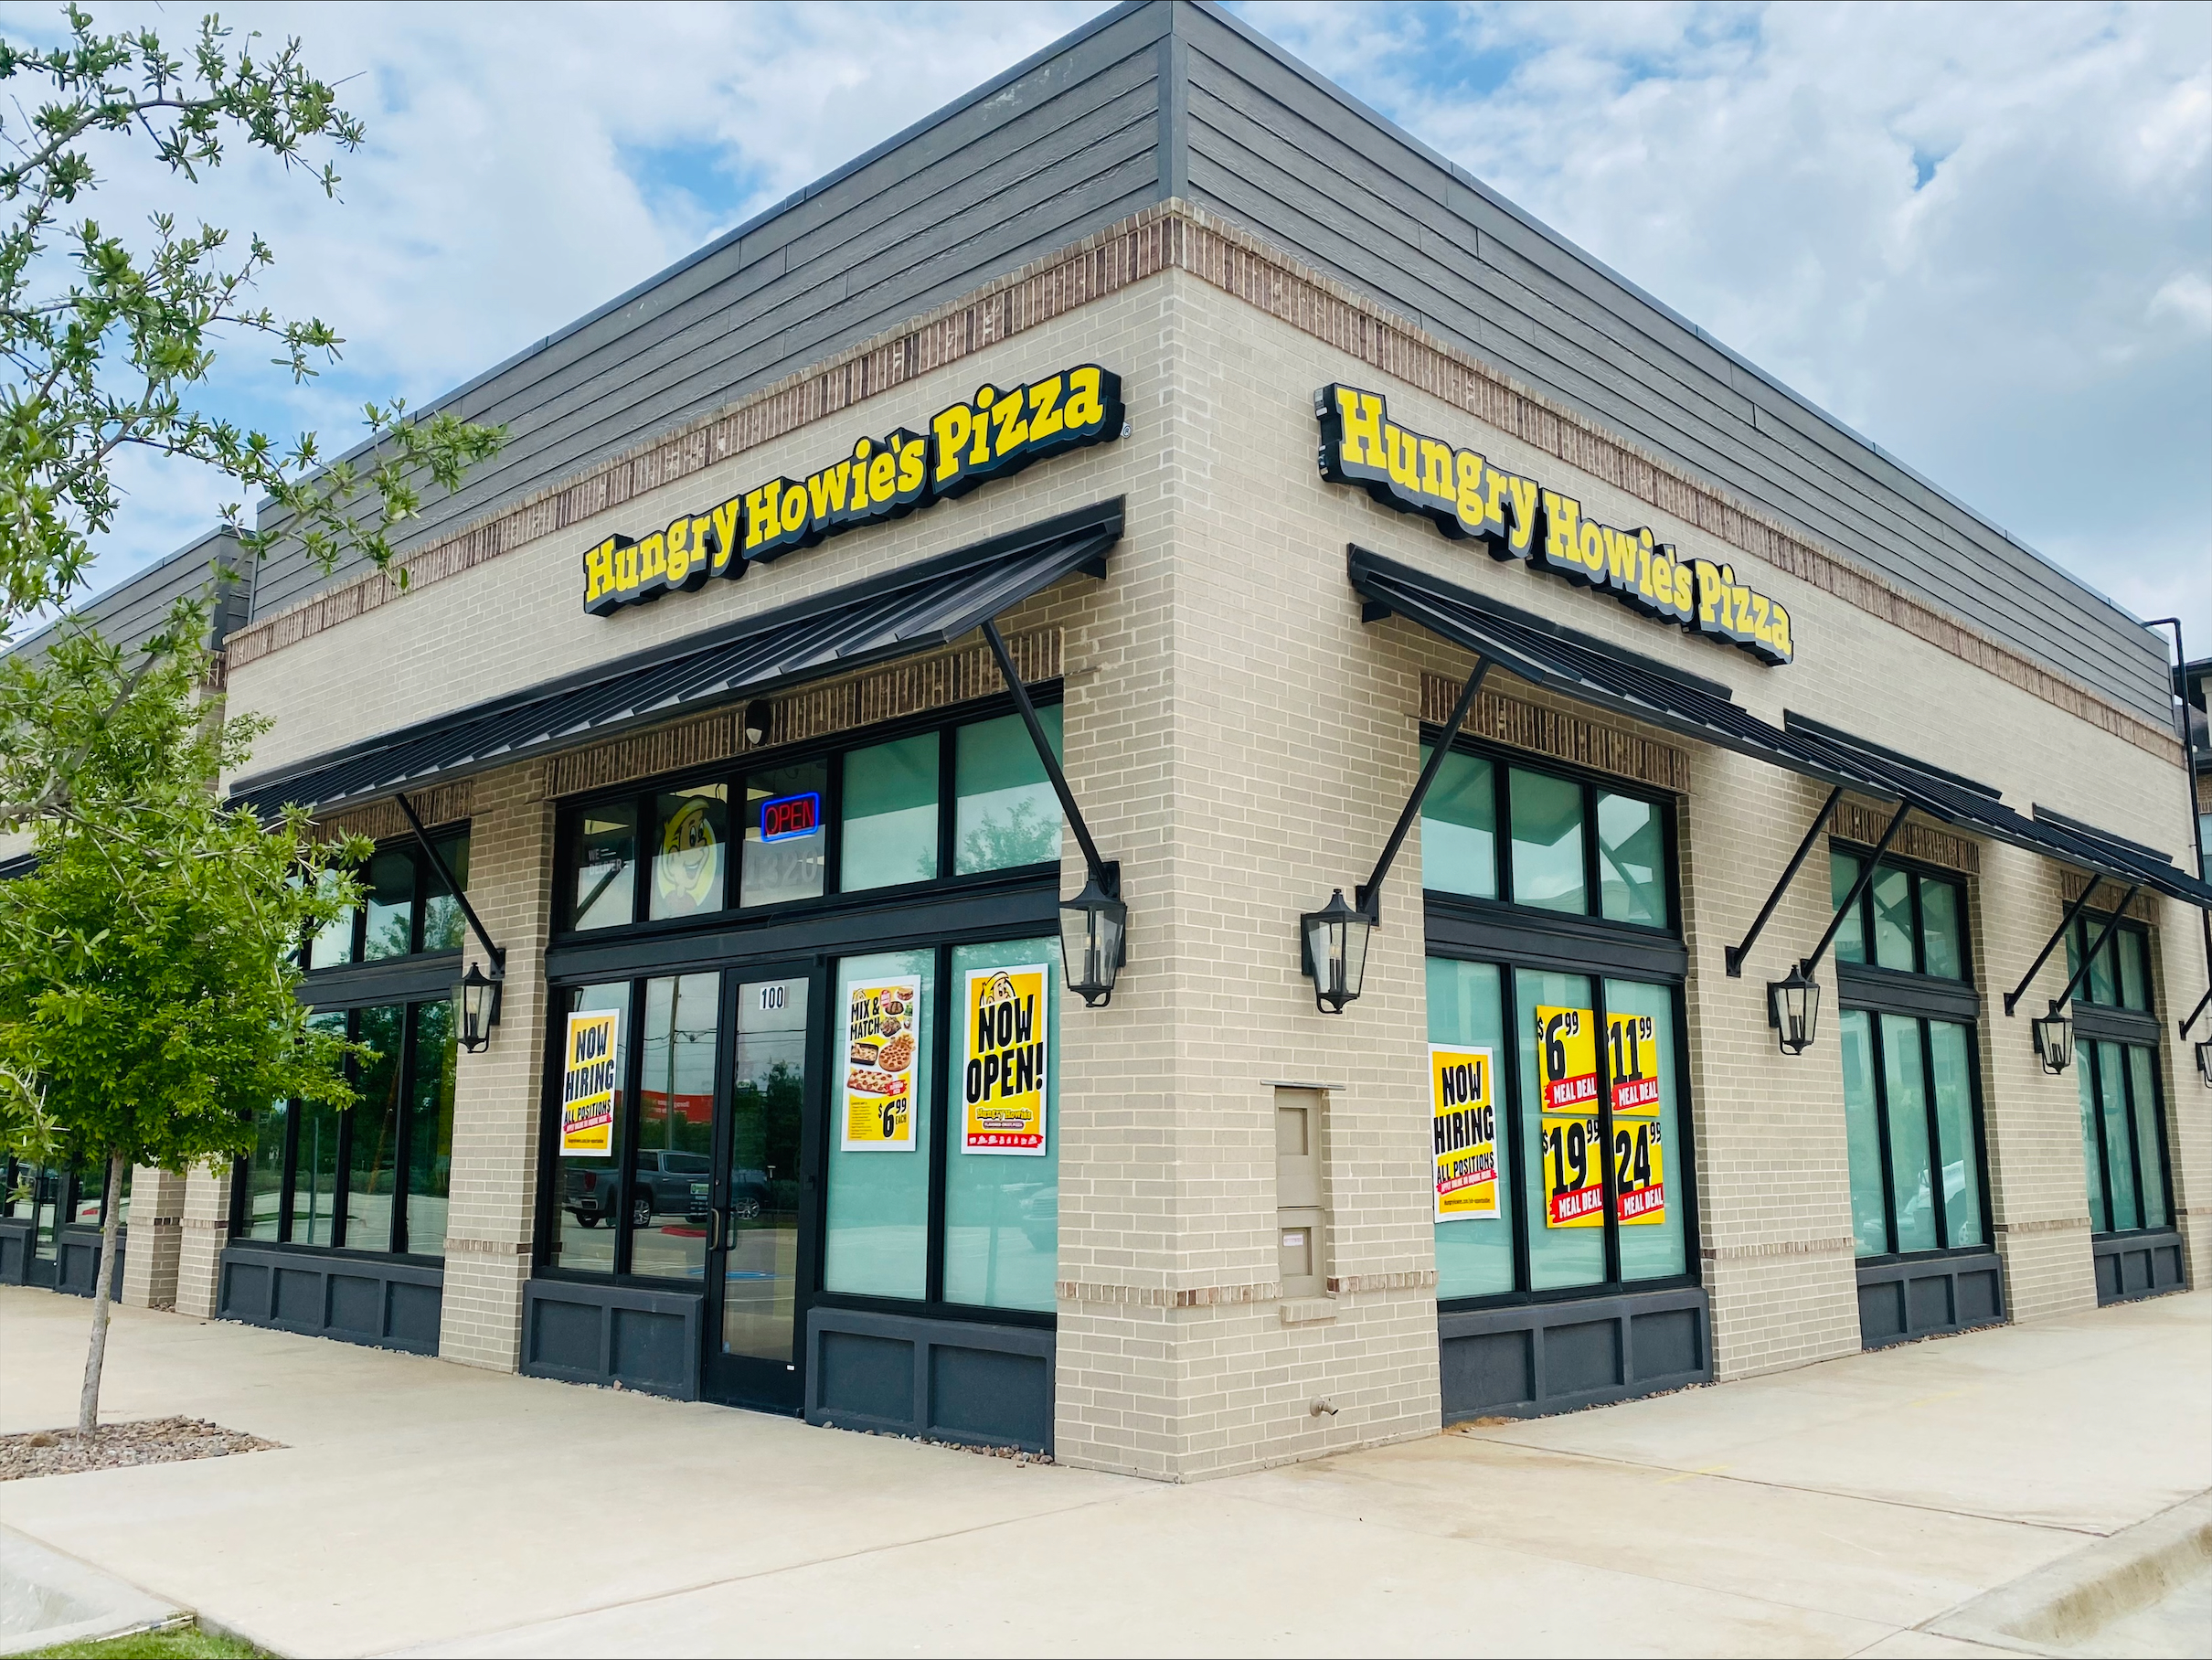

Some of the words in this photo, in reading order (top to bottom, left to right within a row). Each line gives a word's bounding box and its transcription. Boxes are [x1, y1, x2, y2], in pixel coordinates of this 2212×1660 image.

[586, 498, 739, 602] Hungry
[746, 435, 925, 548] Howie's
[933, 367, 1103, 481] Pizza
[1335, 387, 1538, 548] Hungry
[1542, 492, 1692, 612] Howie's
[1696, 560, 1793, 656] Pizza
[765, 800, 815, 835] OPEN
[588, 848, 600, 861] WE
[590, 858, 622, 876] DELIVER
[745, 848, 818, 889] 1320
[762, 986, 783, 1009] 100
[852, 999, 870, 1022] MIX
[873, 997, 880, 1016] &
[850, 1016, 880, 1041] MATCH
[978, 995, 1034, 1053] NOW
[575, 1022, 609, 1064] NOW
[565, 1059, 614, 1102] HIRING
[967, 1042, 1044, 1104] OPEN!
[1441, 1061, 1481, 1107] NOW
[1554, 1080, 1576, 1104] MEAL
[1577, 1077, 1597, 1099] DEAL
[1618, 1085, 1639, 1107] MEAL
[1640, 1081, 1658, 1101] DEAL
[564, 1110, 576, 1125] ALL
[578, 1099, 611, 1120] POSITIONS
[896, 1114, 907, 1125] EACH
[977, 1108, 1004, 1121] Hungry
[1005, 1108, 1032, 1121] Howie's
[1433, 1105, 1494, 1155] HIRING
[1437, 1164, 1451, 1184] ALL
[1454, 1152, 1494, 1176] POSITIONS
[1558, 1195, 1581, 1218] MEAL
[1582, 1188, 1602, 1210] DEAL
[1624, 1194, 1644, 1217] MEAL
[1645, 1187, 1664, 1209] DEAL
